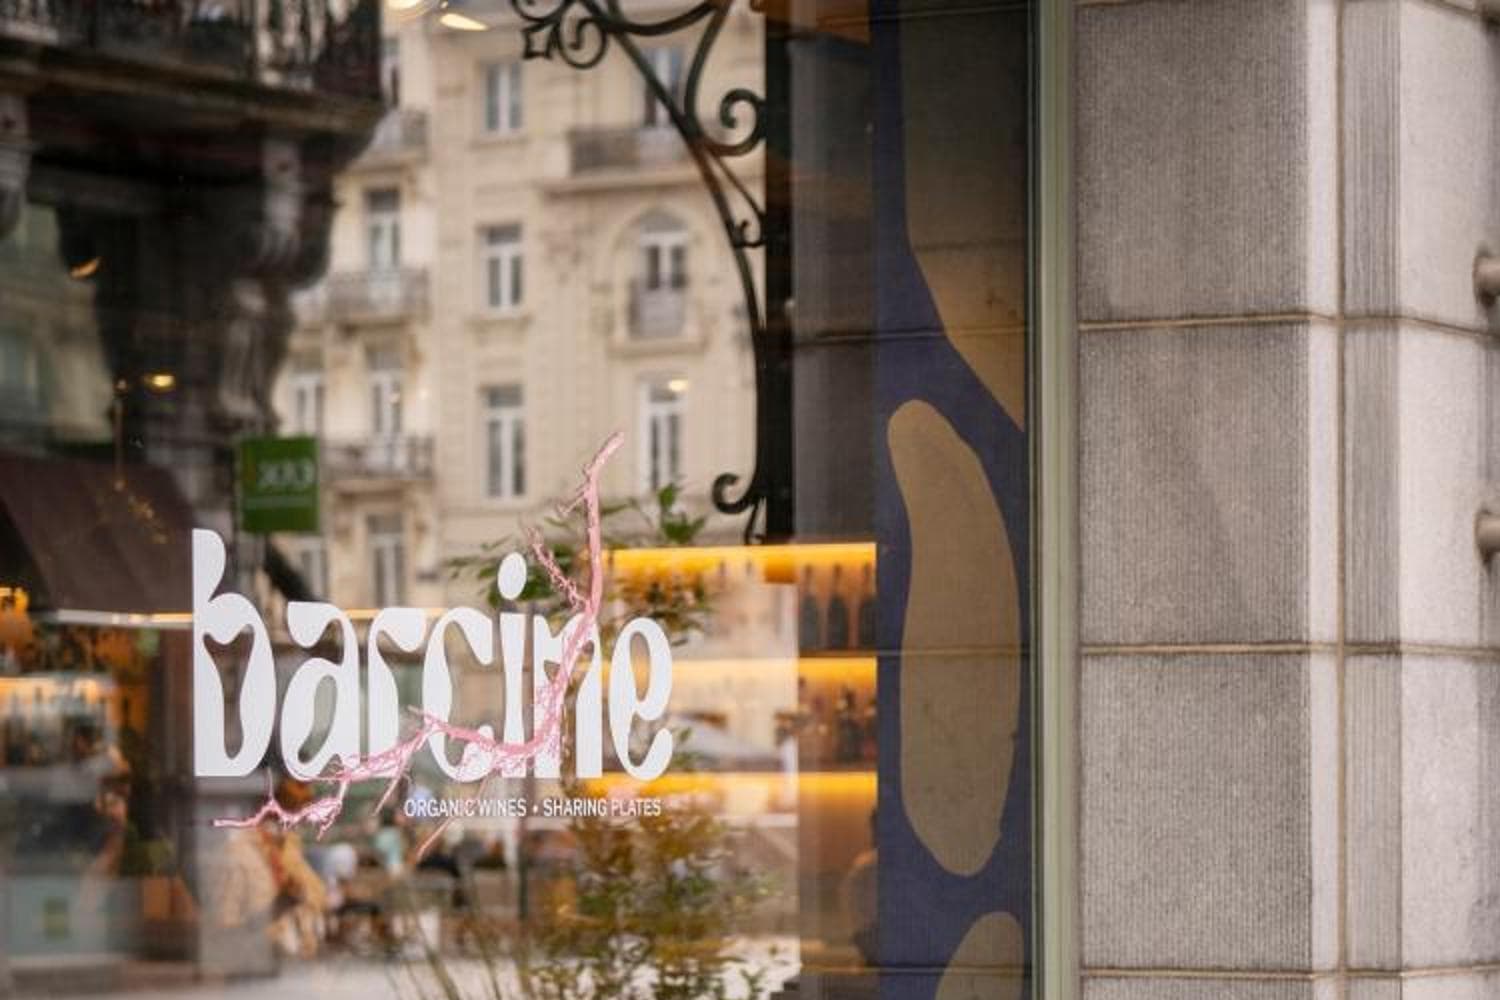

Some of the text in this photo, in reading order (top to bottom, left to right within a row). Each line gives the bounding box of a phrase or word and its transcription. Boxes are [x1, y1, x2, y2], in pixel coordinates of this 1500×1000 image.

[192, 527, 674, 782] barcine
[404, 798, 662, 817] ORGANIC WINES SHARING PLATES
